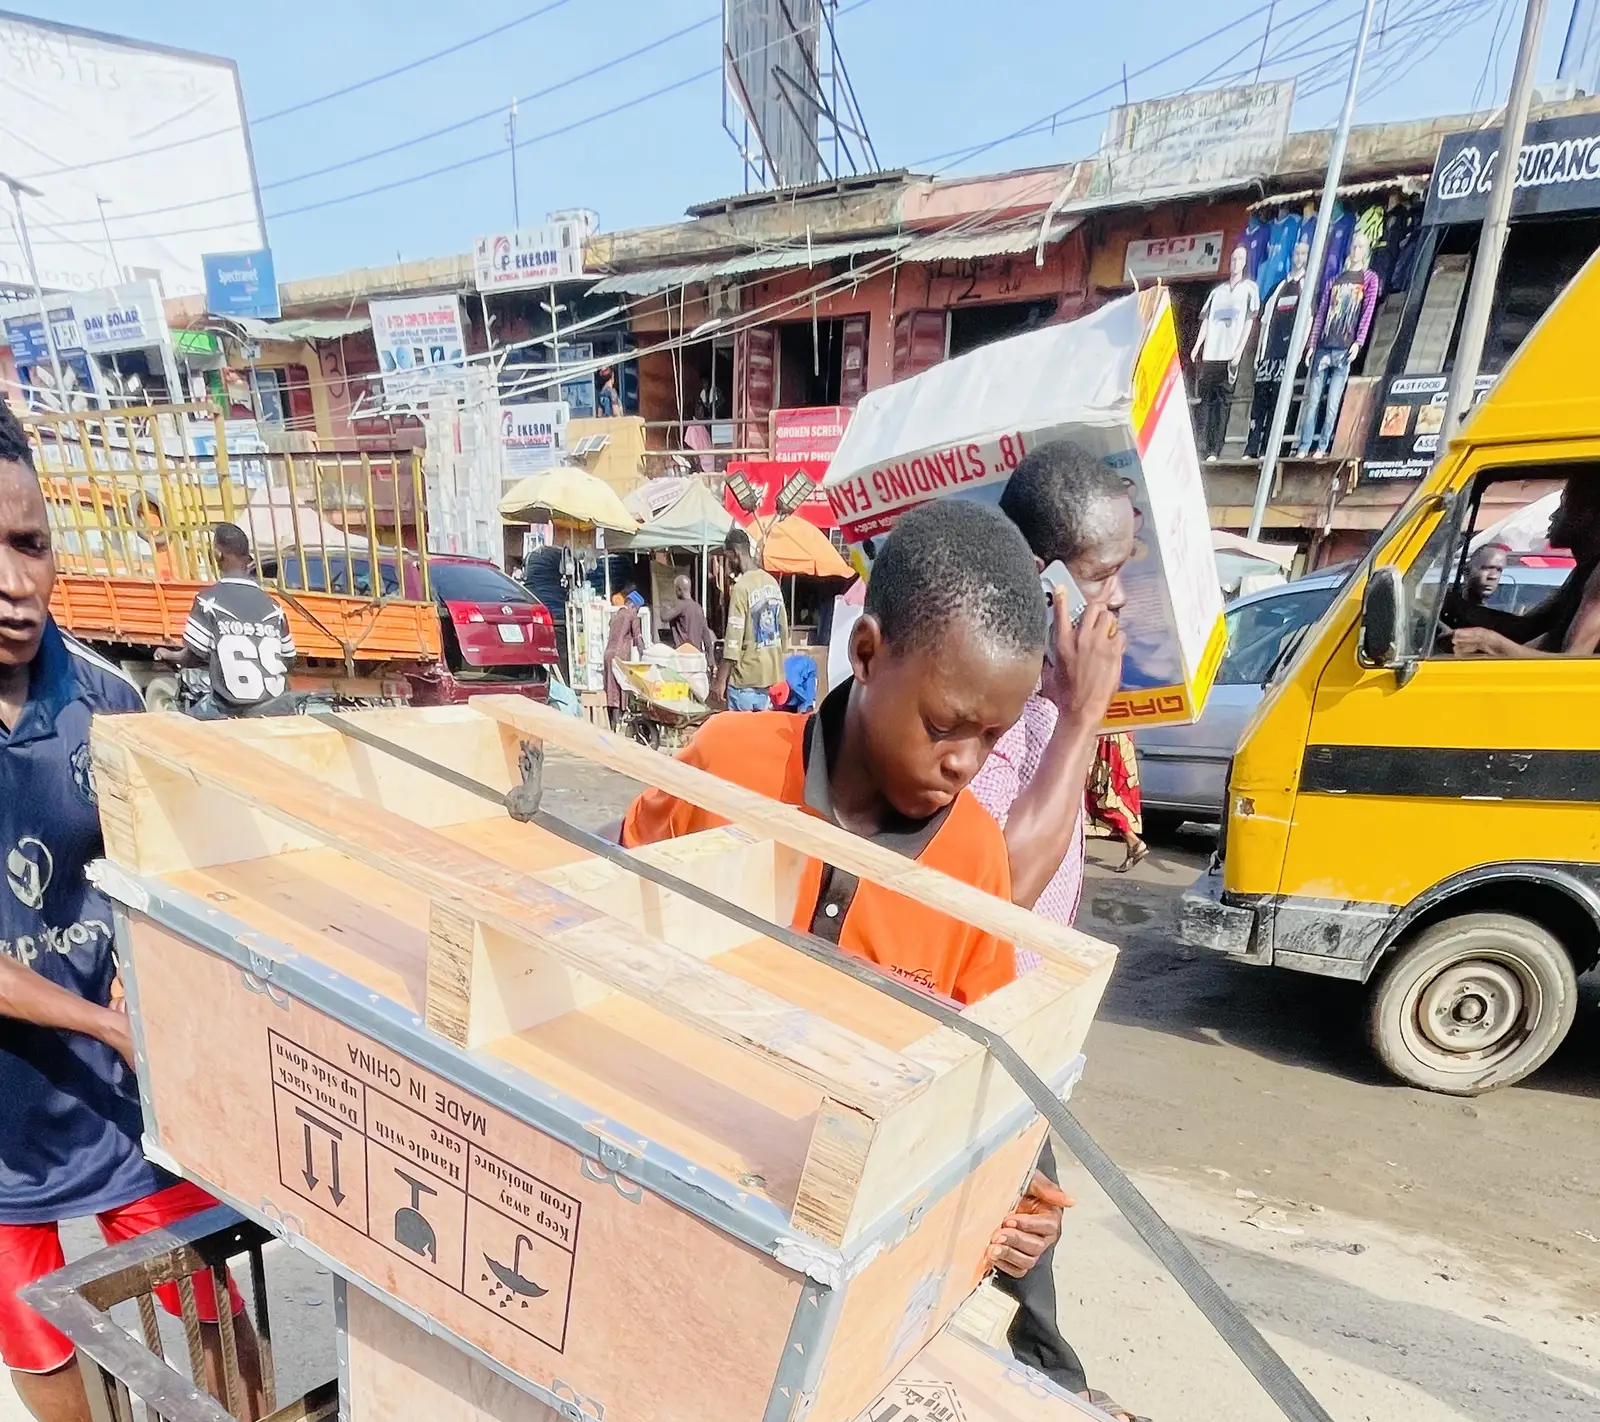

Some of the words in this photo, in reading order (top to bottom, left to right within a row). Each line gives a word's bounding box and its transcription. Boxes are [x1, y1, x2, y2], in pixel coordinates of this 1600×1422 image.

[515, 250, 557, 269] EKESON
[217, 267, 259, 287] Spectranet
[107, 309, 139, 327] SOLAR
[1395, 382, 1416, 390] FAST
[1417, 380, 1441, 389] FOOD
[517, 423, 552, 436] EKESON
[776, 426, 811, 438] BROKEN
[811, 425, 843, 437] SCREEN
[872, 444, 986, 504] STANDING
[824, 477, 870, 519] FAN
[1105, 695, 1184, 720] QAS
[276, 1043, 309, 1067] down
[347, 1043, 401, 1088] CHINA
[279, 1067, 312, 1094] stack
[312, 1064, 338, 1087] side
[316, 1088, 336, 1109] not
[341, 1082, 357, 1098] up
[409, 1077, 427, 1103] IN
[340, 1104, 358, 1125] Do
[435, 1092, 486, 1136] MADE
[375, 1120, 405, 1146] with
[430, 1129, 462, 1154] care
[409, 1140, 460, 1180] Handle
[474, 1154, 534, 1195] moisture
[499, 1189, 530, 1217] away
[540, 1190, 572, 1220] from
[536, 1210, 569, 1242] Keep
